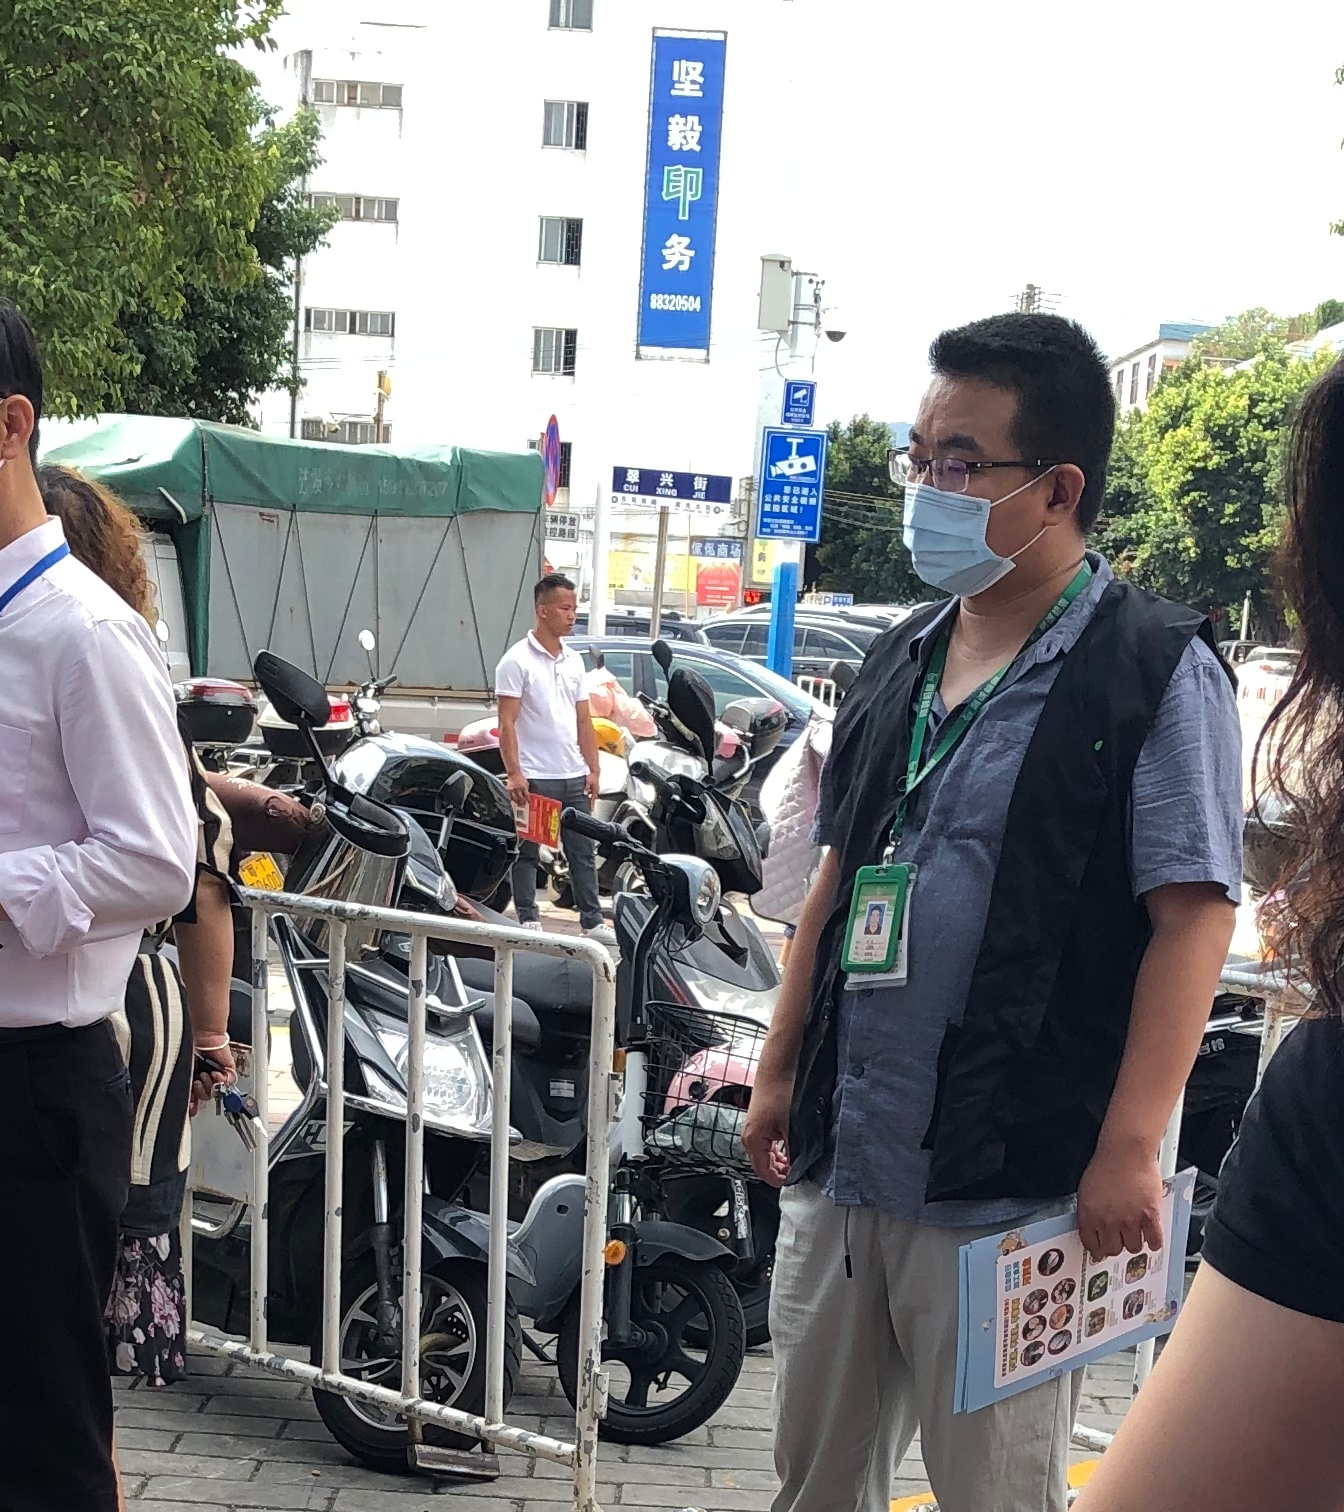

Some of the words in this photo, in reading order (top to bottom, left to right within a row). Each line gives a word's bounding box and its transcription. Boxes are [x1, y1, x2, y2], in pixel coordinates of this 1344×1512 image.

[660, 59, 705, 271] 坚毅印务
[650, 293, 701, 312] 88320504
[623, 484, 639, 493] CUI
[625, 468, 708, 491] 翠兴街
